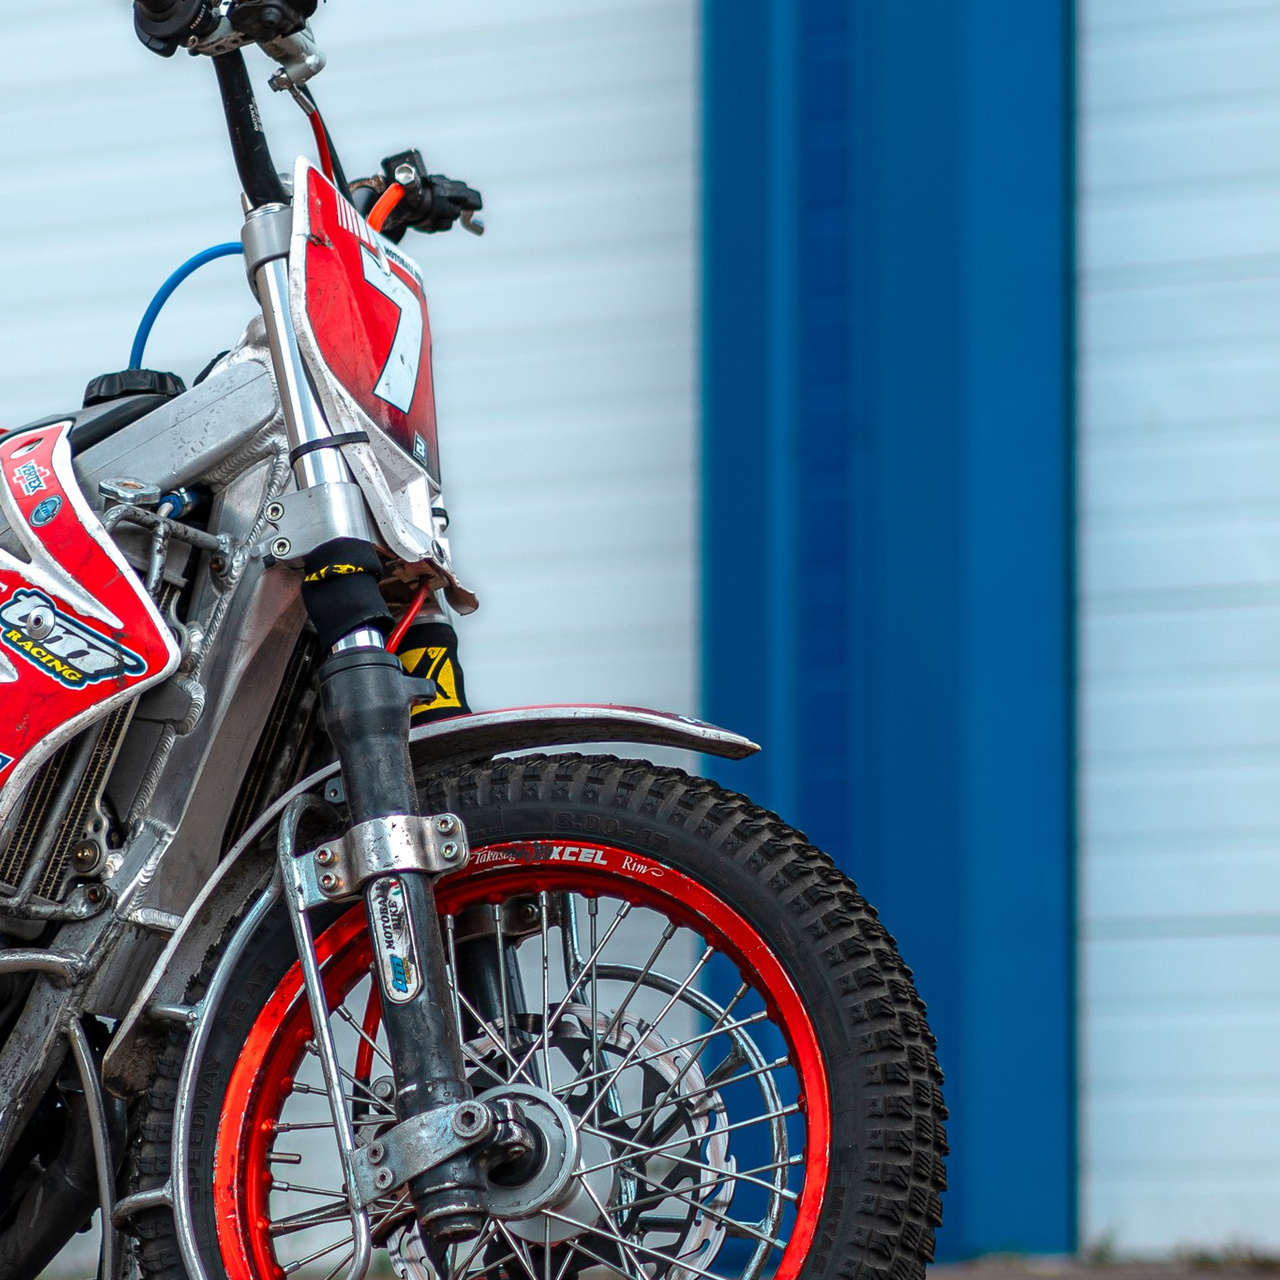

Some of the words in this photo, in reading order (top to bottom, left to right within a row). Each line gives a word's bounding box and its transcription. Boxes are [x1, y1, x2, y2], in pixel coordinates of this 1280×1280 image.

[21, 461, 44, 493] VERTEX
[4, 629, 83, 682] RACING
[621, 855, 661, 877] Rim
[388, 899, 401, 931] BIKE
